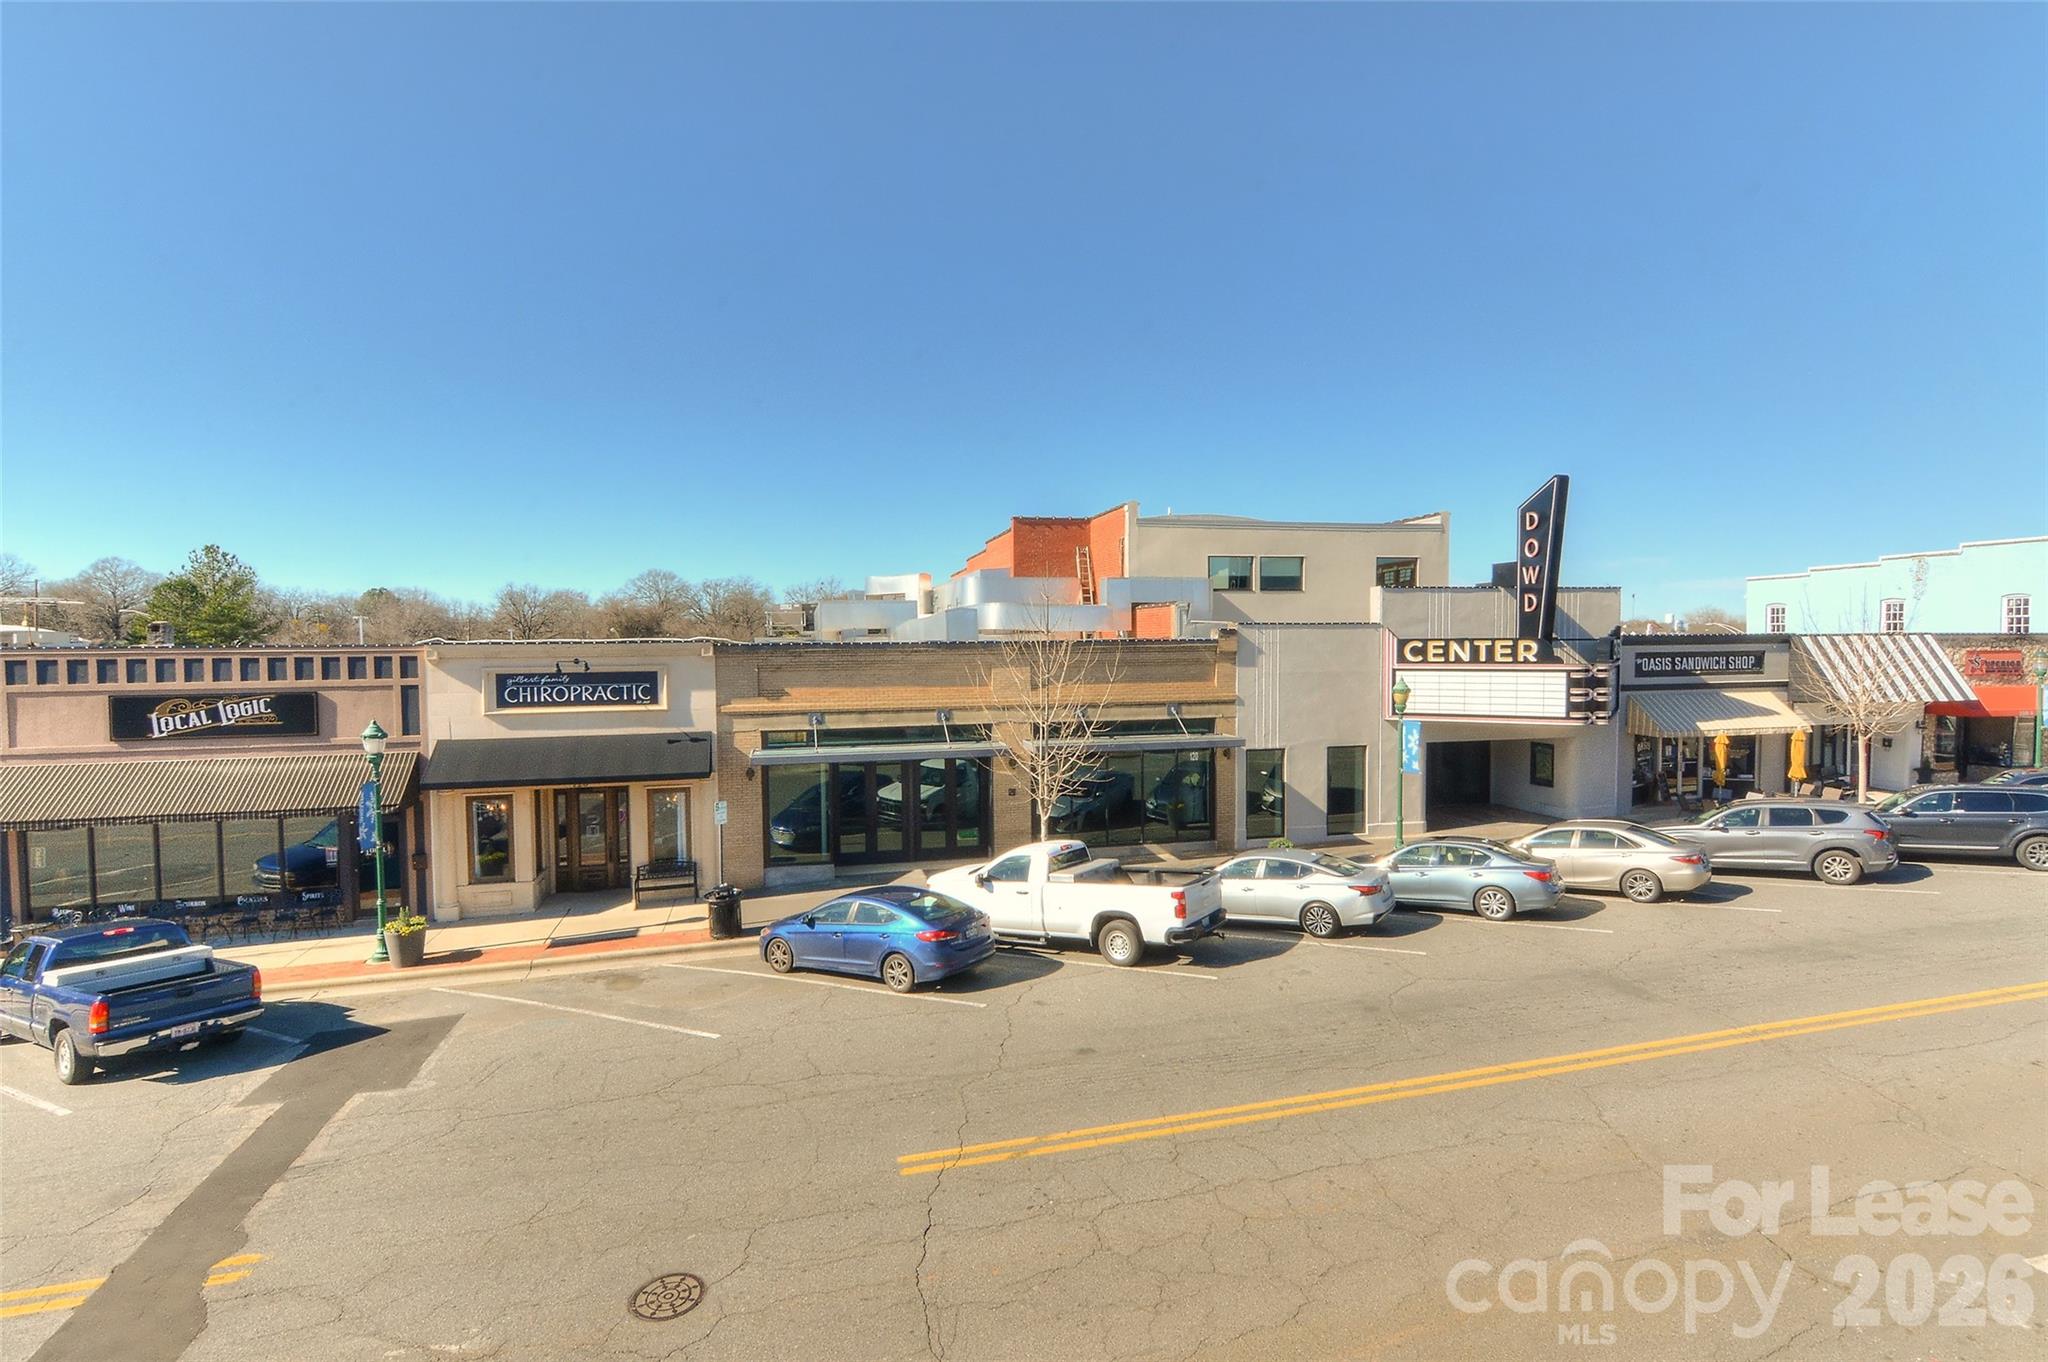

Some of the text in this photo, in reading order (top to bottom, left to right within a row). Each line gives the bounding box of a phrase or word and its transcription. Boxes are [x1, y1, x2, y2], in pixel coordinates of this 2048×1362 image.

[1522, 511, 1540, 612] DOWD
[1403, 639, 1538, 662] CENTER
[1642, 657, 1672, 671] OASIS
[1675, 656, 1726, 670] SANDWICH
[1728, 655, 1755, 669] SHOP
[504, 684, 651, 704] CHIROPRACTIC
[148, 697, 271, 738] LOCAL LOGIC
